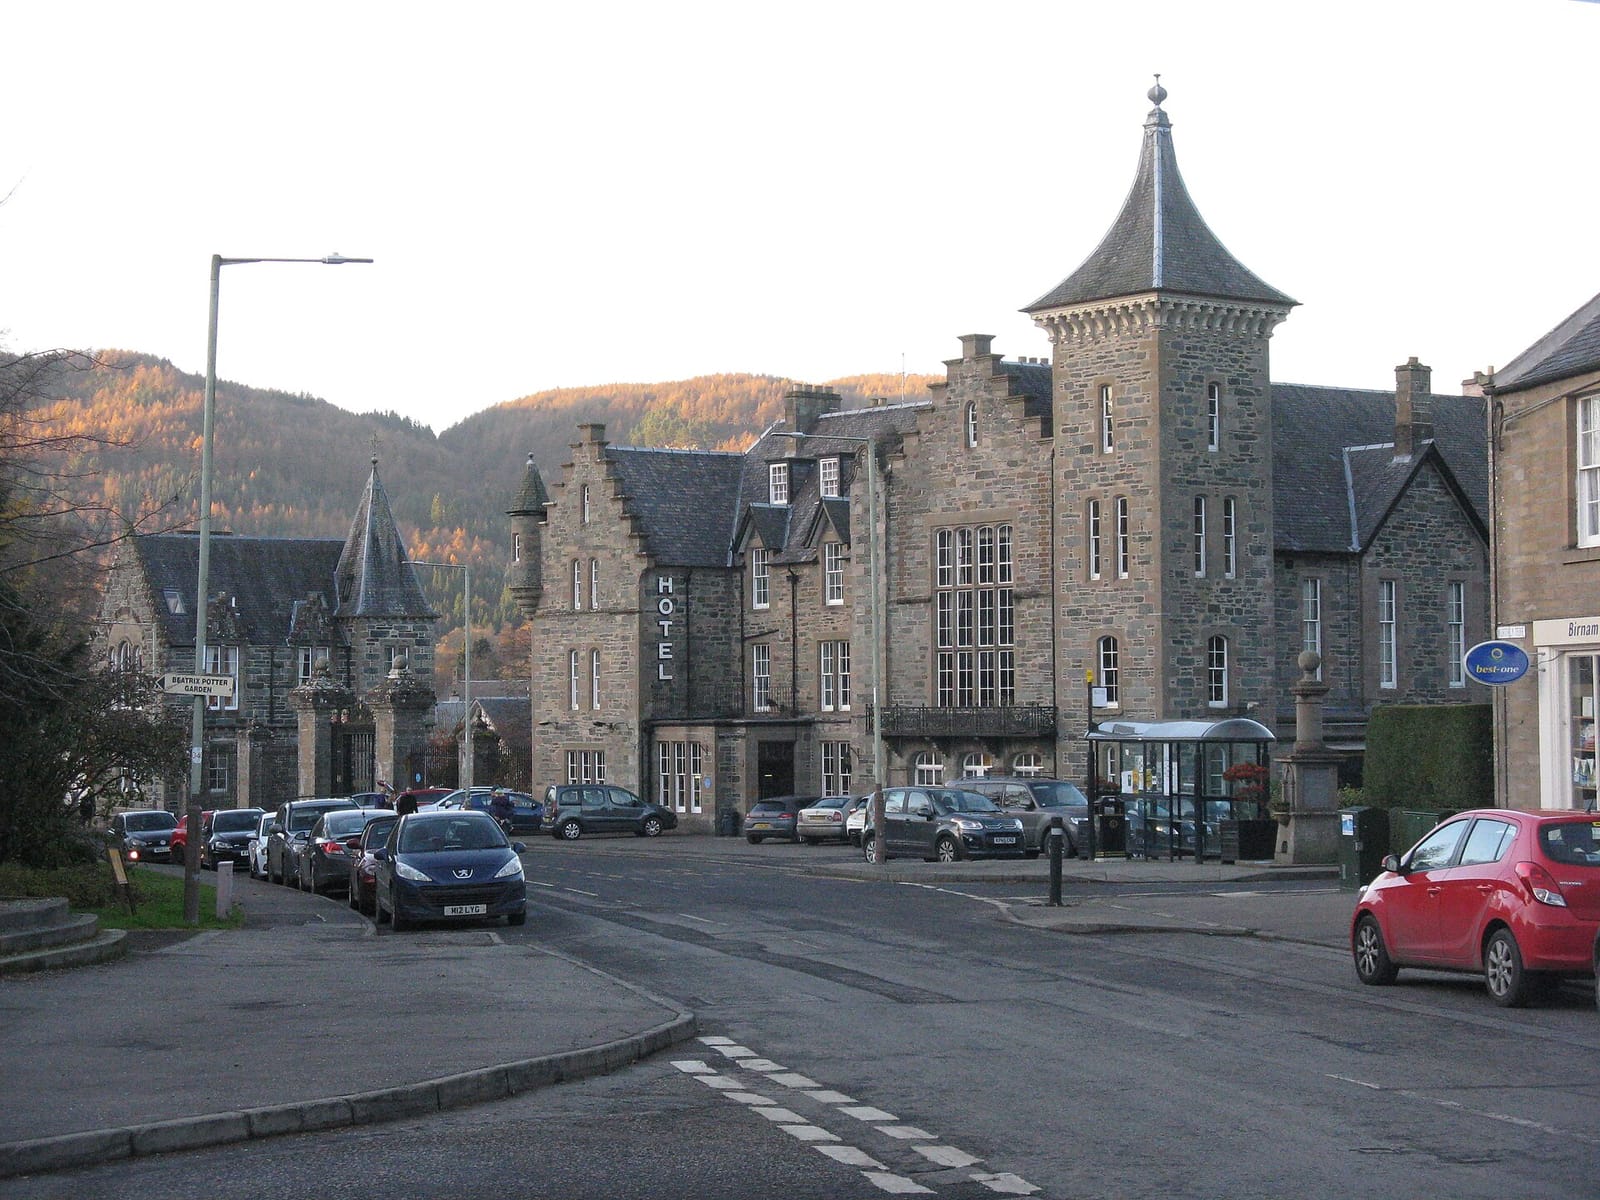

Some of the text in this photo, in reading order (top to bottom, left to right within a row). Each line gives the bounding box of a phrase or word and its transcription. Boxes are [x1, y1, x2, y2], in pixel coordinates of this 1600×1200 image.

[658, 576, 673, 680] HOTEL
[1568, 622, 1599, 637] Birnam
[1476, 664, 1519, 674] best-one
[172, 676, 228, 686] BEATRIX POTTER
[184, 685, 212, 693] GARDEN
